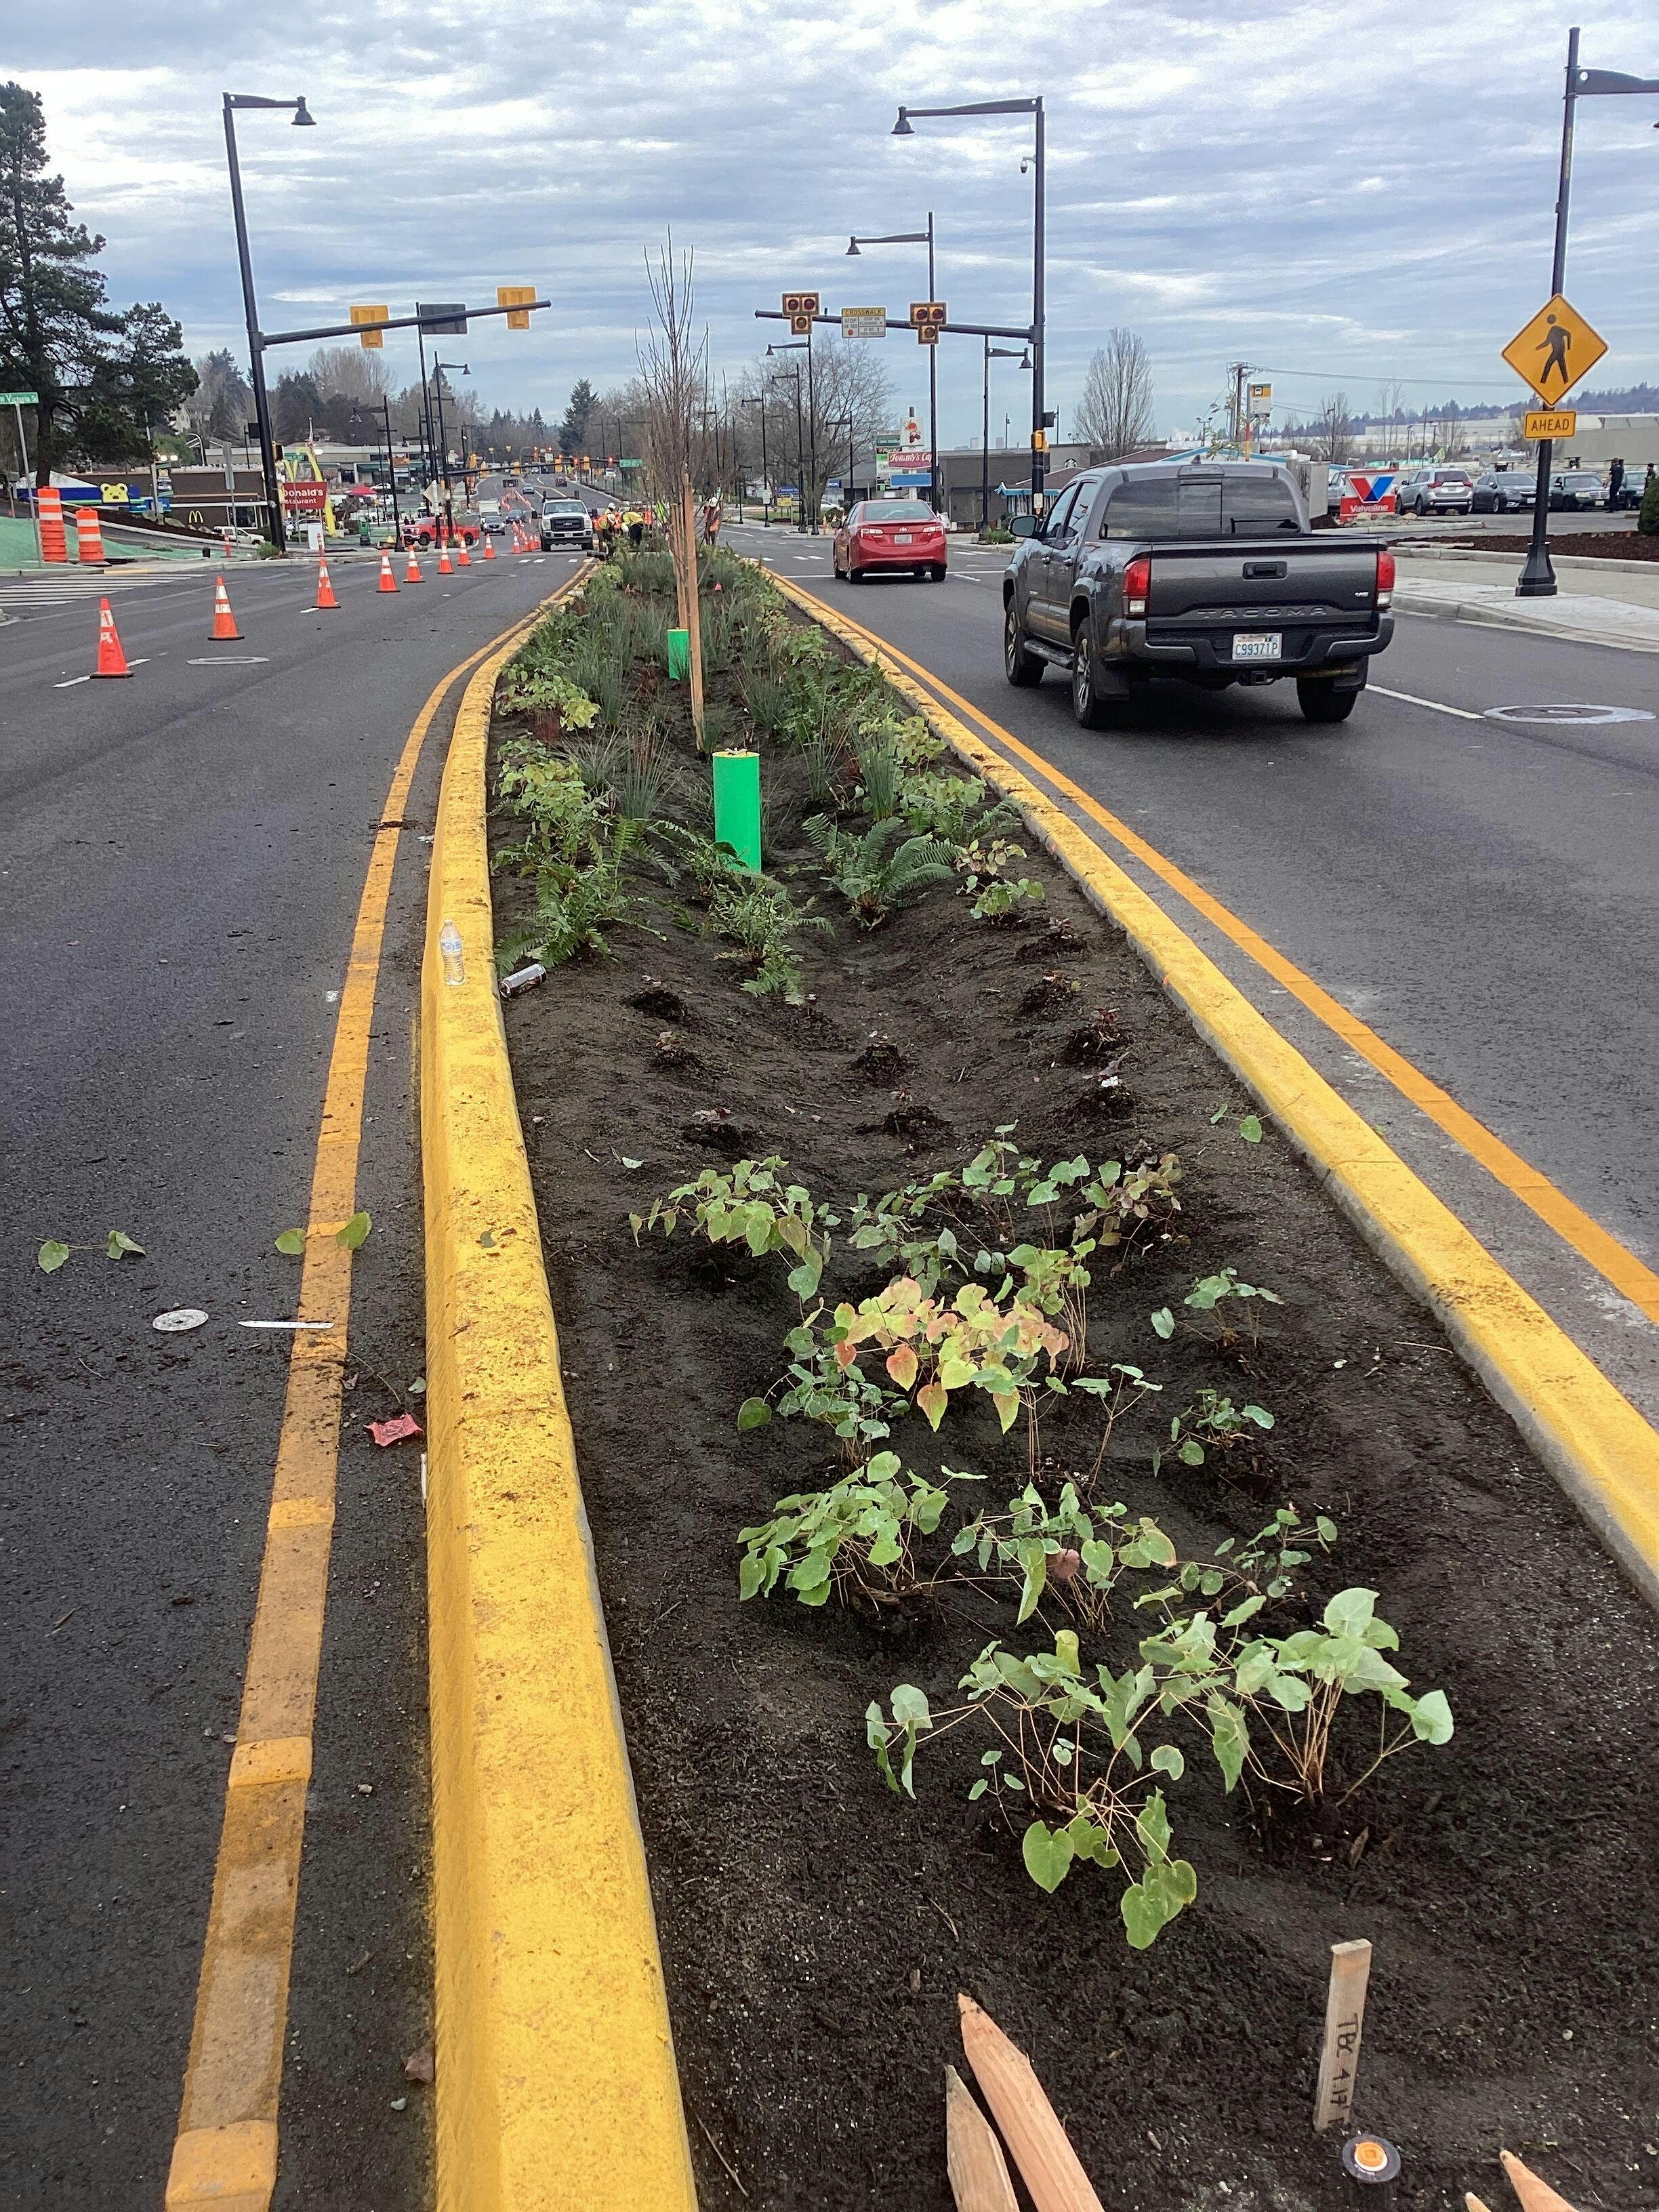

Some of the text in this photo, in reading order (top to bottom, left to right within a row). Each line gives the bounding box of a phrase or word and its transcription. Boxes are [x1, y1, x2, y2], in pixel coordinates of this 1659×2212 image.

[1531, 418, 1570, 432] AHEAD
[889, 453, 920, 463] Tommy's
[1350, 504, 1389, 514] Valvoline
[1197, 607, 1328, 619] TACOMA
[1235, 642, 1278, 655] C99371P
